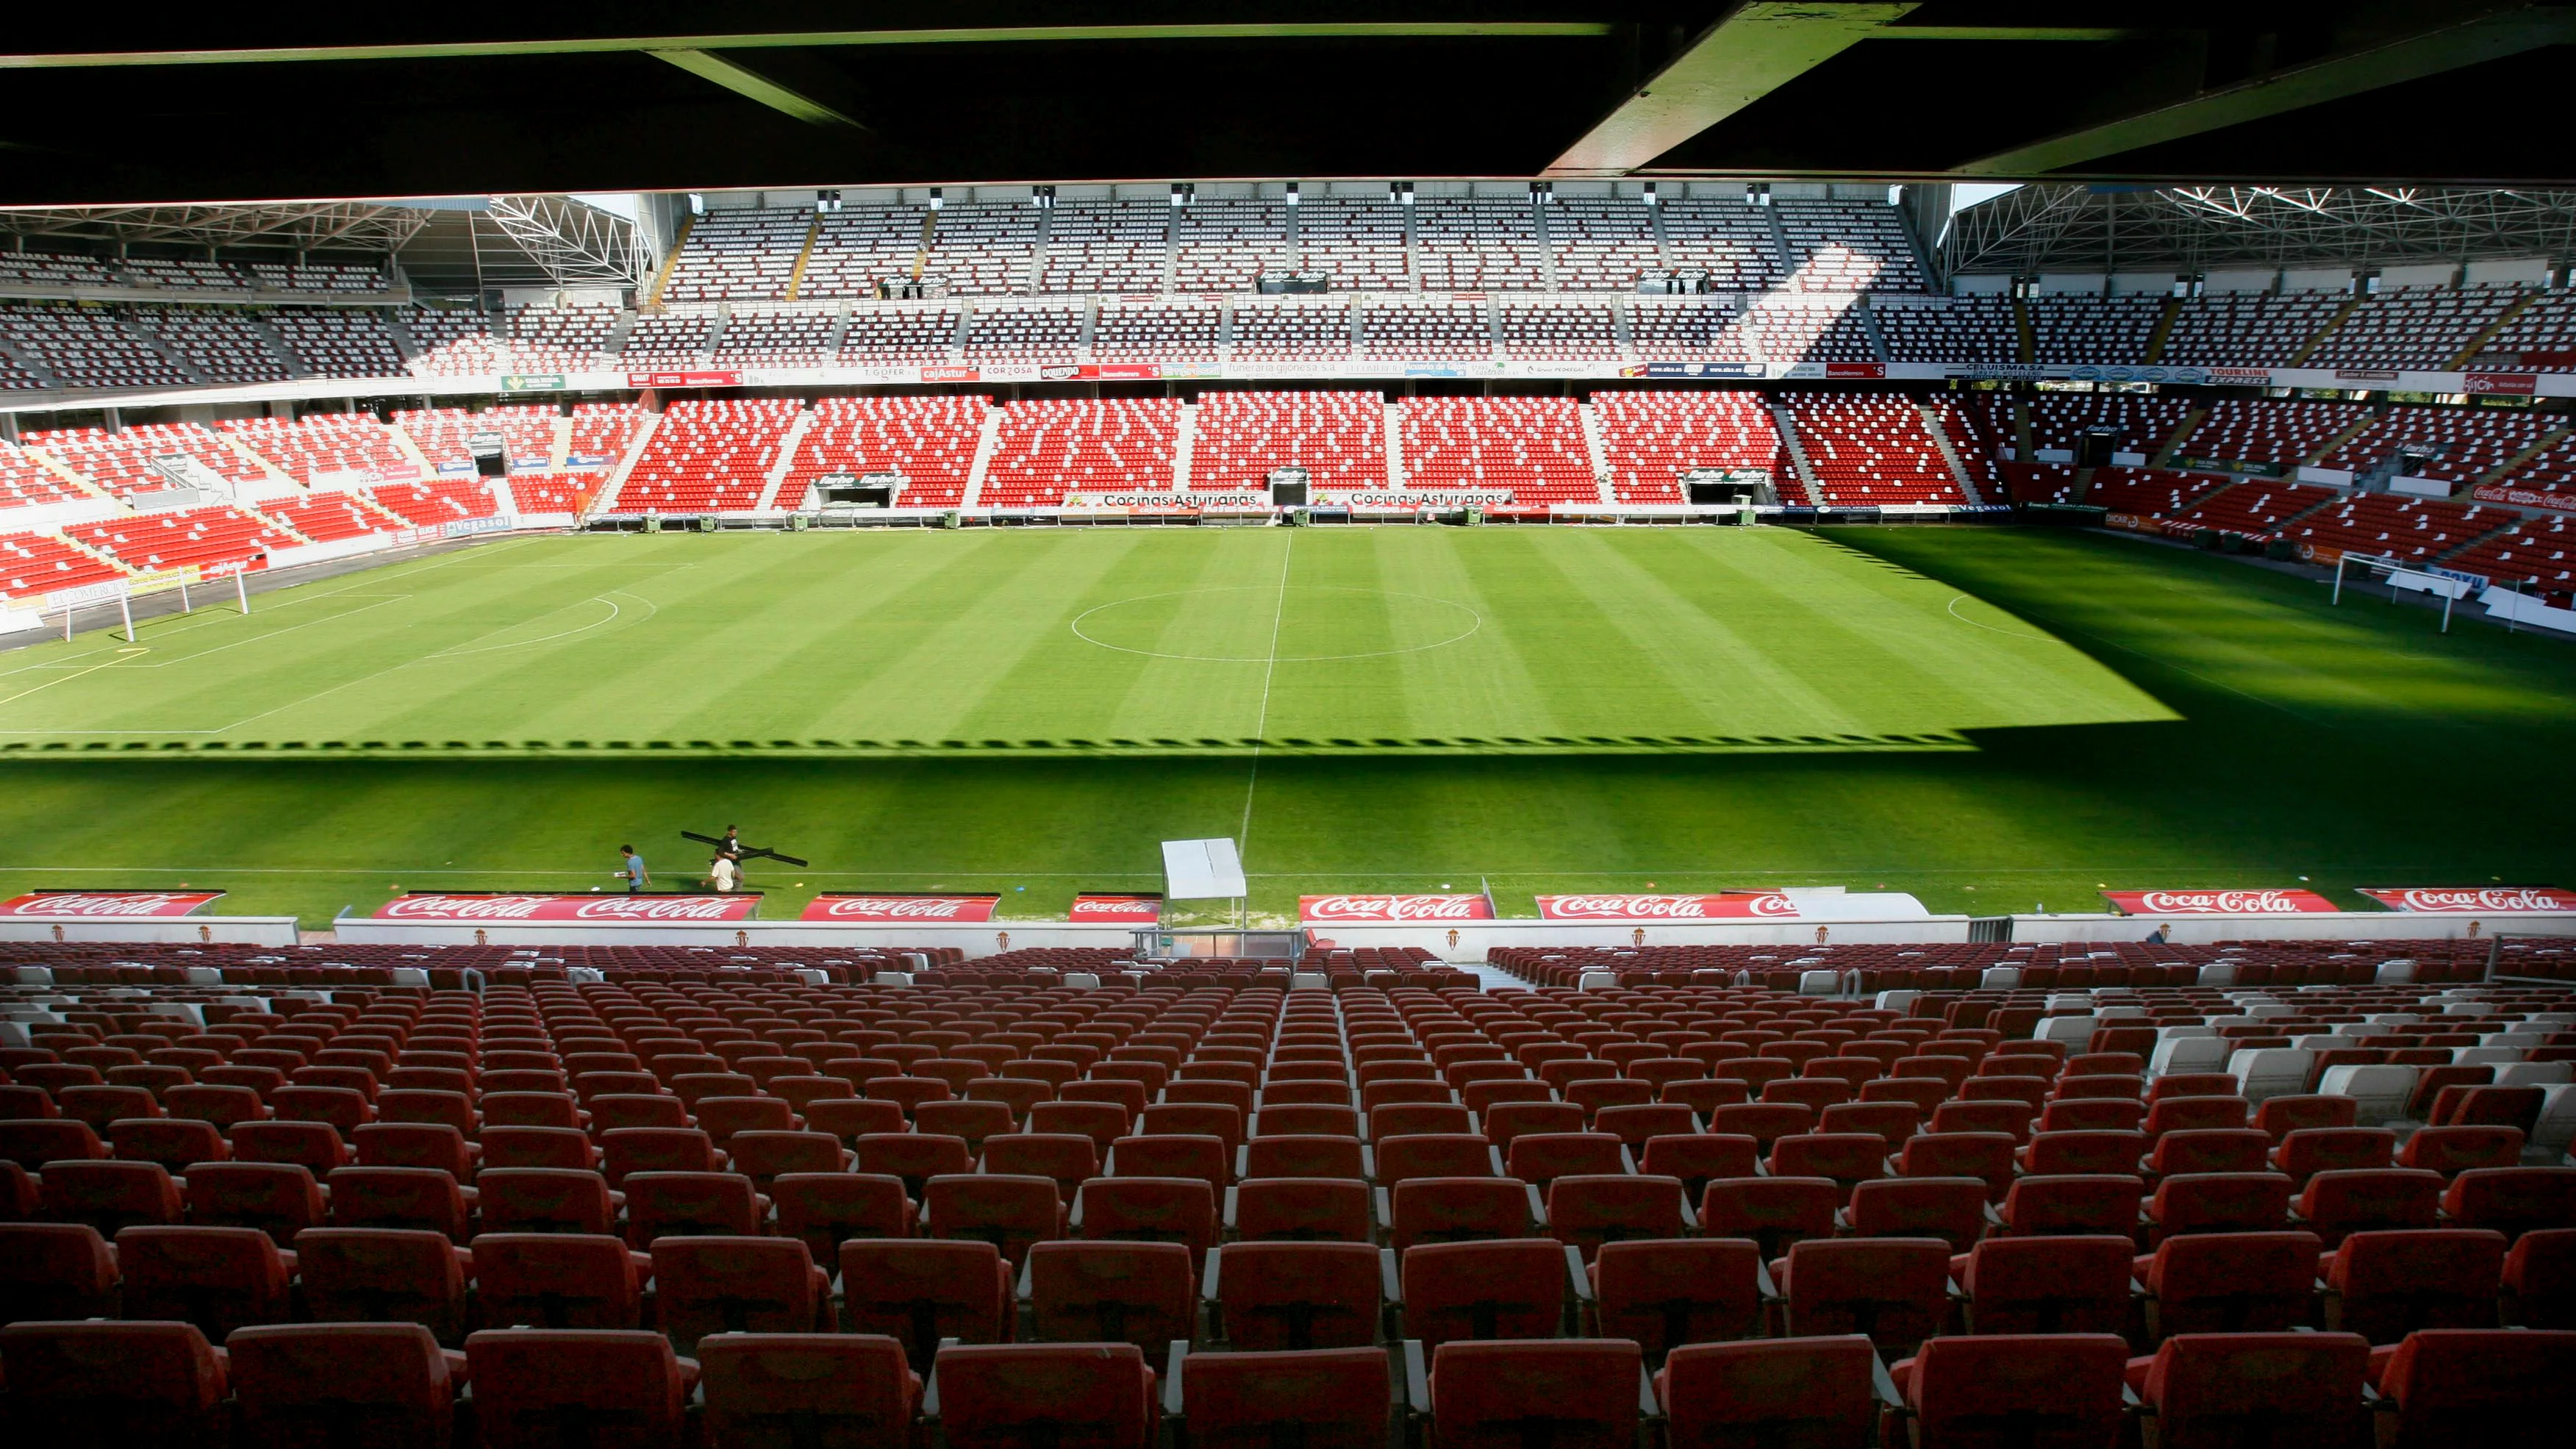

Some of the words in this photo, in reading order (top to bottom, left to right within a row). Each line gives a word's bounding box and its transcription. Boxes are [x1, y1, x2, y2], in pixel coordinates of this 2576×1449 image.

[923, 368, 967, 380] cajAstur
[987, 367, 1032, 376] CORZOSA
[1042, 367, 1079, 378] OQUENDO
[1229, 363, 1273, 372] funeraria
[1276, 363, 1317, 375] gijonesa
[2210, 368, 2269, 376] TOURLINE
[2208, 376, 2269, 384] EXPRESS
[1687, 471, 1725, 479] farho
[1729, 471, 1767, 479] farho
[1351, 493, 1414, 505] Cocinas
[1420, 493, 1502, 505] Asturianas
[2474, 487, 2507, 501] Coca-Cola
[1104, 495, 1169, 506] Cocinas
[1175, 495, 1256, 506] Asturianas
[1958, 504, 2011, 512] Vegasol
[454, 516, 510, 532] Vegasol
[15, 894, 193, 916] Coca-Cola
[388, 895, 562, 918] Coca-Cola
[1550, 895, 1706, 917] Coca-Cola
[2142, 890, 2301, 913] Coca-Cola
[2404, 889, 2567, 912] Coca-Cola
[576, 896, 765, 920] Coca-Cola
[829, 898, 969, 918] Coca-Cola
[1074, 901, 1153, 914] Coca-Cola
[1309, 895, 1479, 920] Coca-Cola
